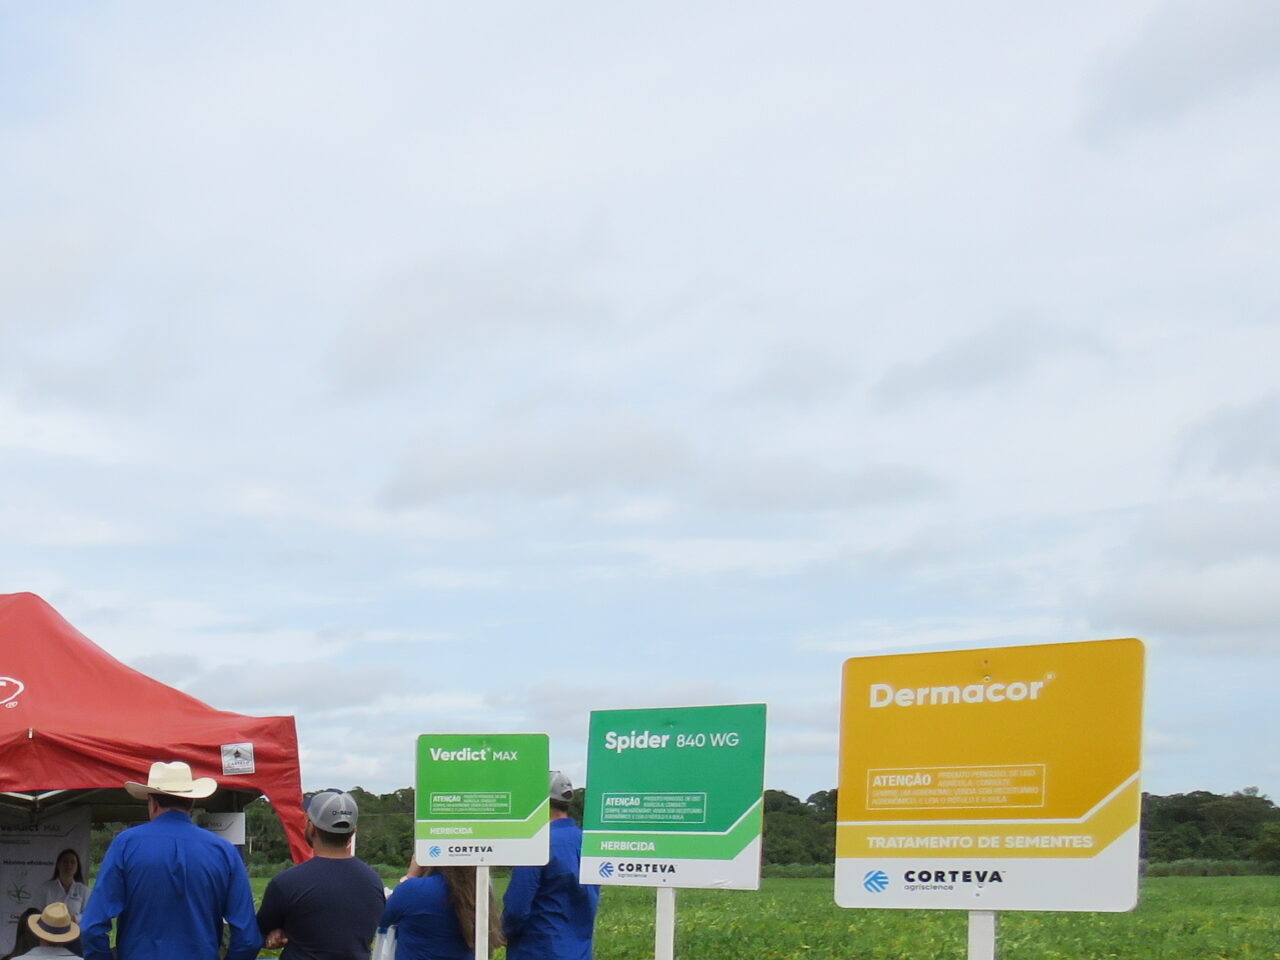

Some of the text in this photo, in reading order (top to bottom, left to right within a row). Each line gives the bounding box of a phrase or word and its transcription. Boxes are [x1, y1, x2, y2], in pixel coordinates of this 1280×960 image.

[869, 680, 1045, 708] Dermacor
[605, 731, 740, 754] Spider 840 WG
[429, 747, 518, 761] Verdict MAX
[600, 841, 656, 851] HERBICIDA
[867, 835, 1094, 849] TRATAMENTO DE SEMENTES
[617, 862, 677, 874] CORTEVA
[904, 869, 1004, 884] CORTEVA
[903, 883, 954, 892] agriscience
